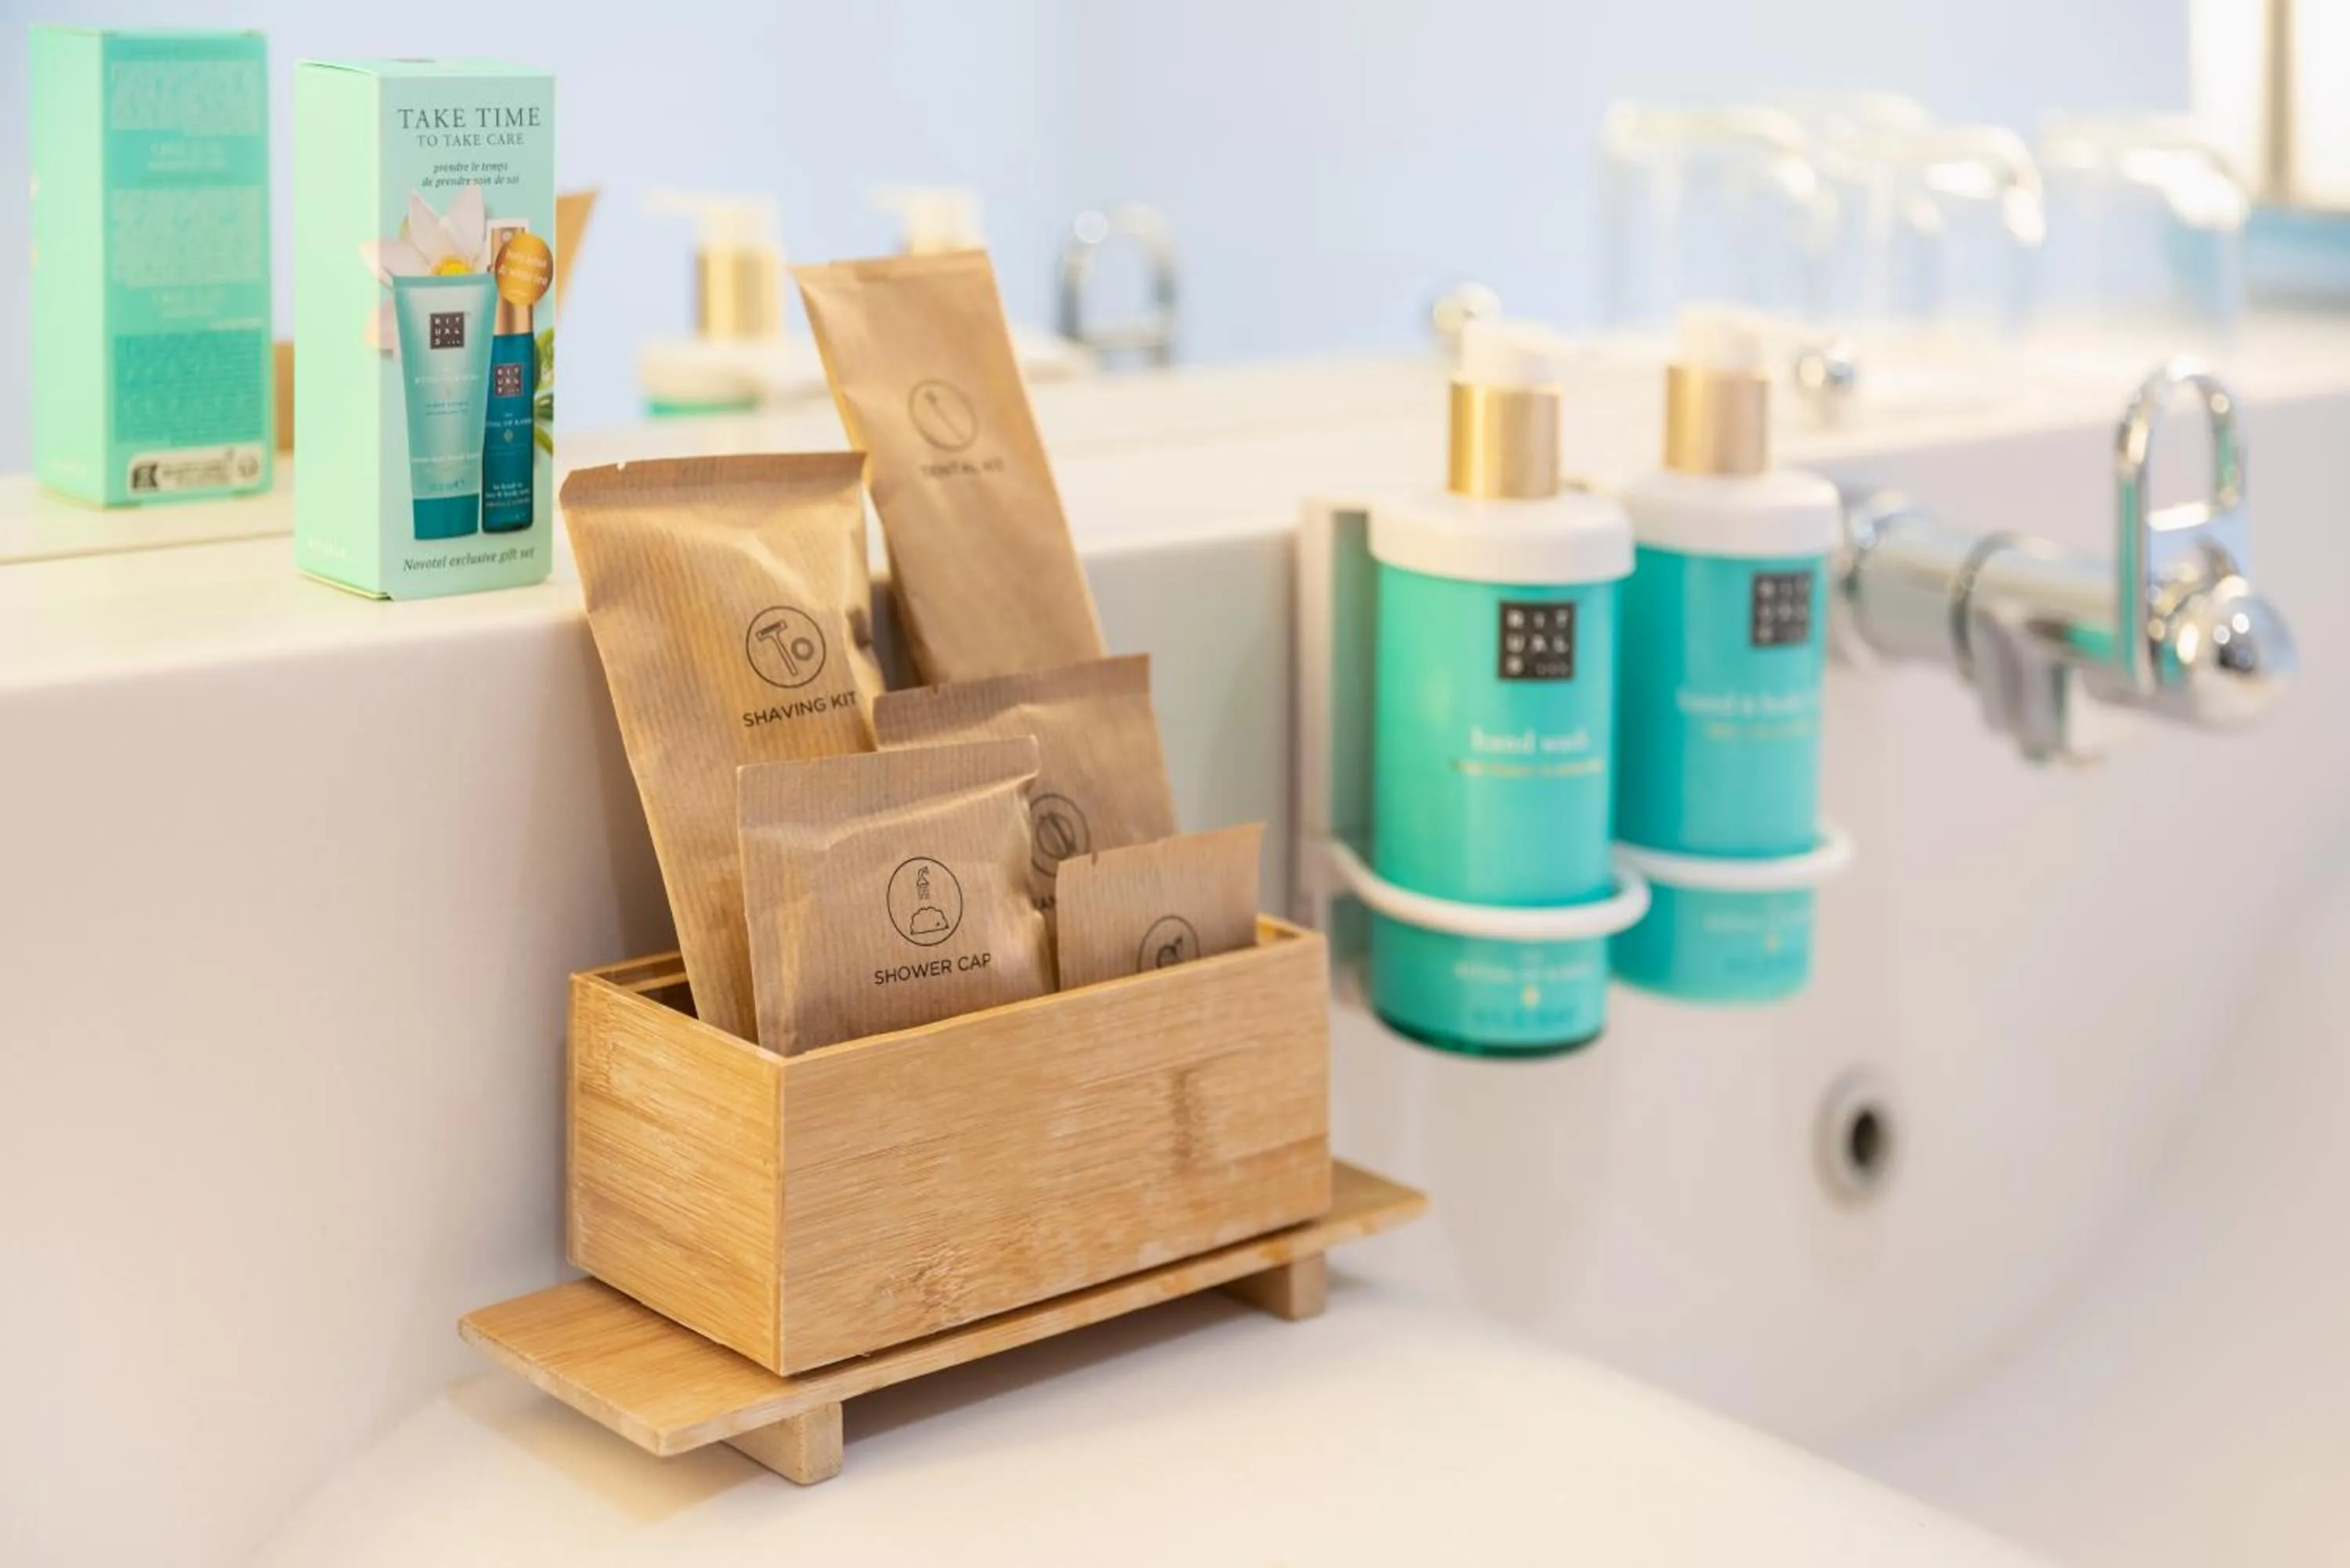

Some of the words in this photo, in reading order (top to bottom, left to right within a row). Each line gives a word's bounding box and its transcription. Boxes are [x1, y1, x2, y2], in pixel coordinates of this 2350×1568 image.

[397, 108, 466, 129] TAKE
[475, 107, 540, 128] TIME
[417, 135, 438, 147] TO
[443, 133, 481, 147] TAKE
[486, 132, 525, 146] CARE
[403, 556, 447, 572] Novotel
[449, 551, 497, 566] exclusive
[499, 547, 518, 562] gift
[743, 697, 827, 728] SHAVING
[830, 691, 857, 710] KIT
[873, 959, 953, 985] SHOWER
[957, 952, 992, 972] CAP
